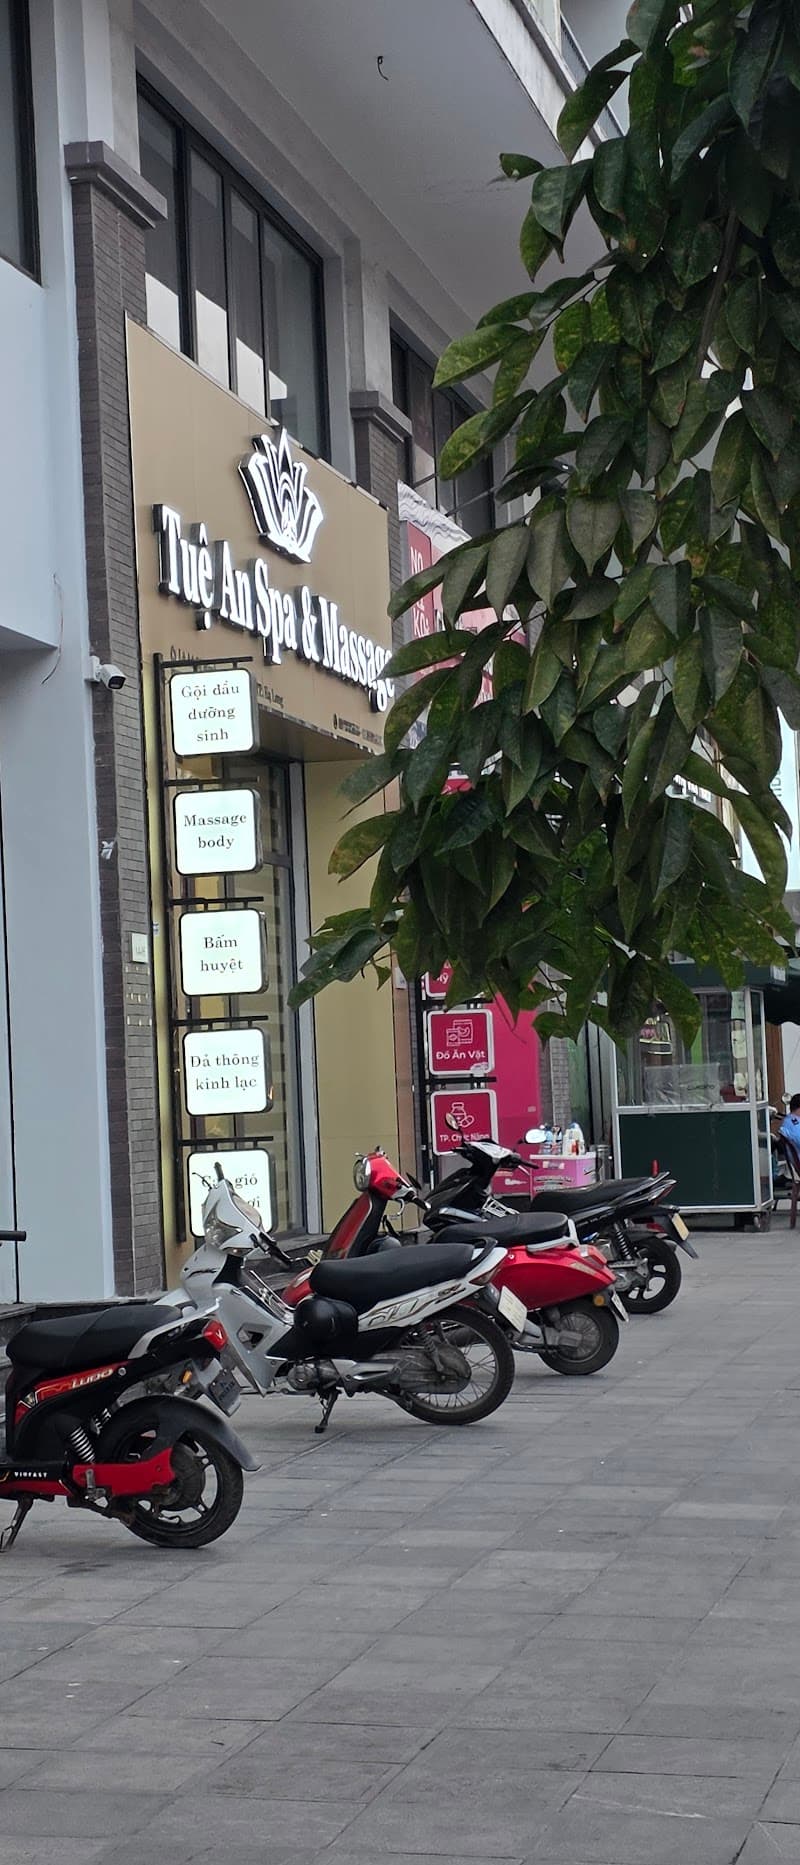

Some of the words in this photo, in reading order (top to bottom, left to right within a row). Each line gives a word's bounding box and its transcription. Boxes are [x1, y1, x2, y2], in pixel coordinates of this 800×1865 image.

[157, 503, 214, 630] Tuệ
[218, 540, 254, 631] An
[253, 557, 297, 665] Spa
[300, 585, 320, 663] &
[181, 684, 207, 701] Gội
[188, 706, 236, 720] dưỡng
[196, 727, 229, 742] sinh
[183, 812, 247, 827] Massage
[197, 834, 235, 850] body
[200, 958, 243, 974] huyệt
[196, 1076, 231, 1091] kinh
[235, 1075, 257, 1091] lạc
